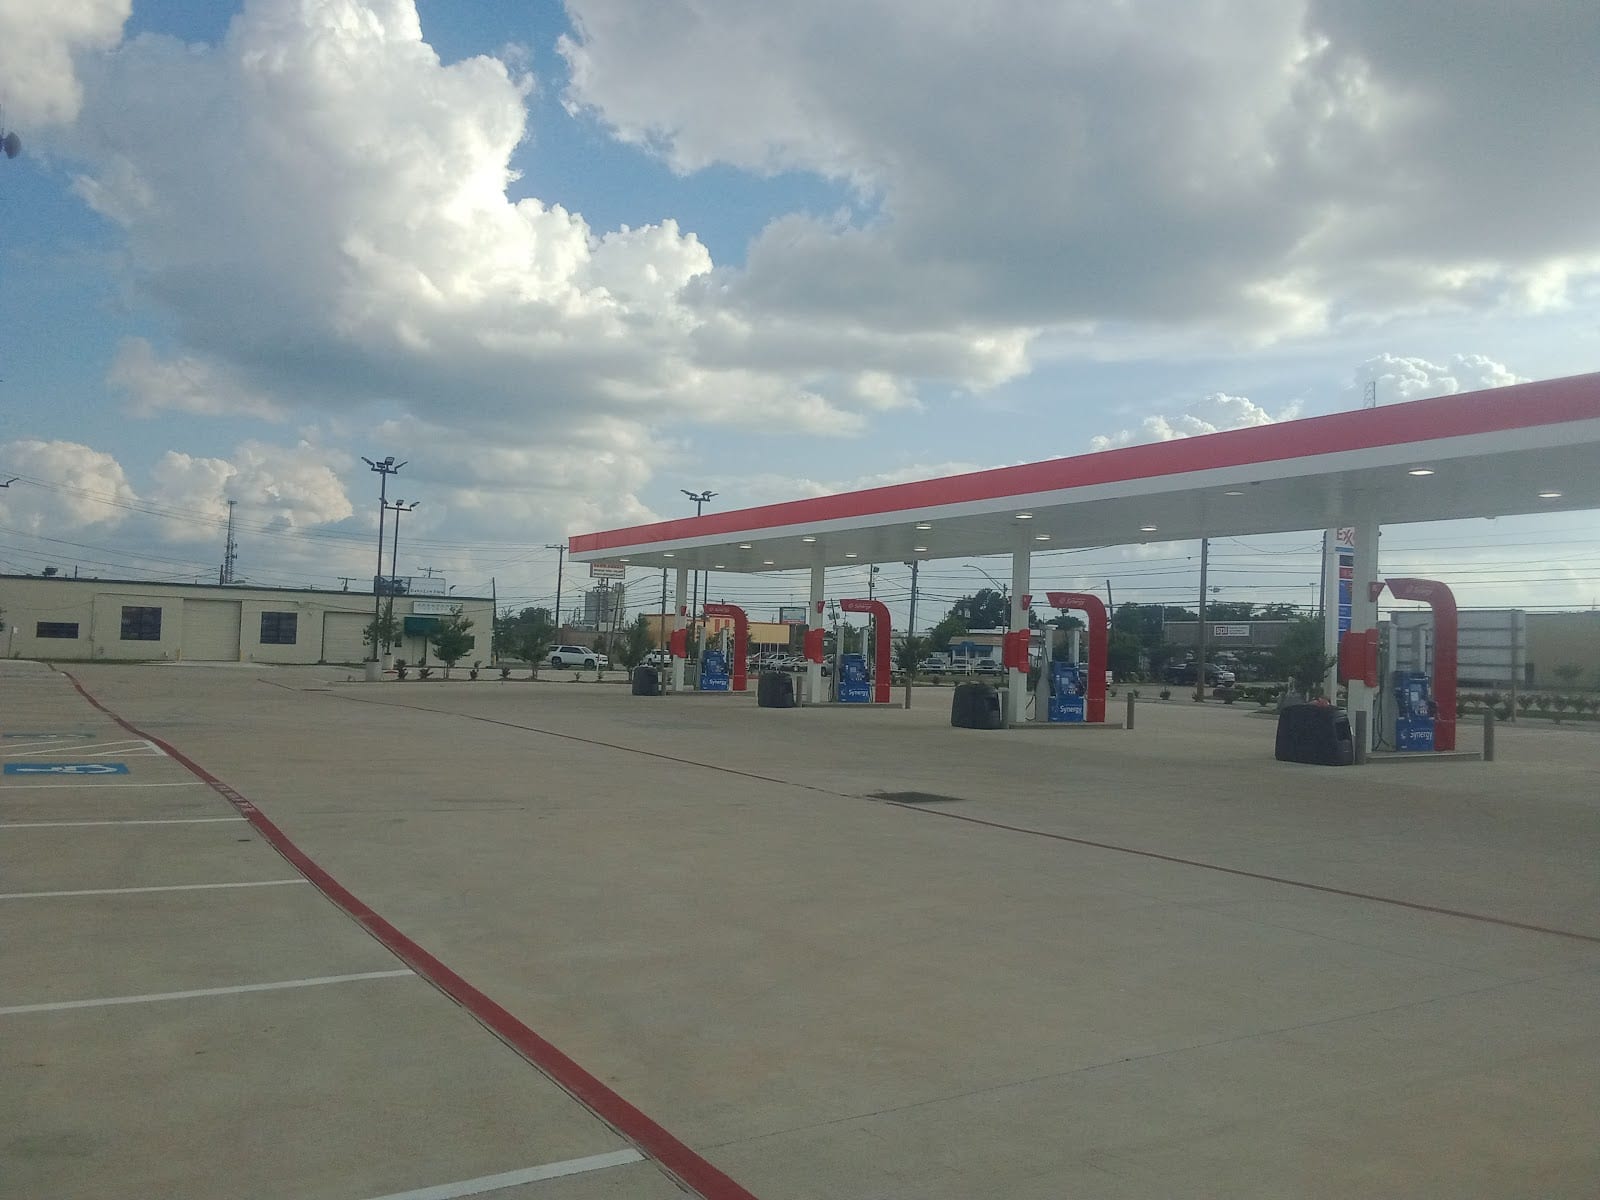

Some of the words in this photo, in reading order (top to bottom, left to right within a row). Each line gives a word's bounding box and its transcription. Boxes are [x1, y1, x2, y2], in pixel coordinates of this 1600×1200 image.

[849, 689, 869, 697] Synergy
[1060, 705, 1082, 714] Synergy
[1410, 729, 1432, 740] Synergy
